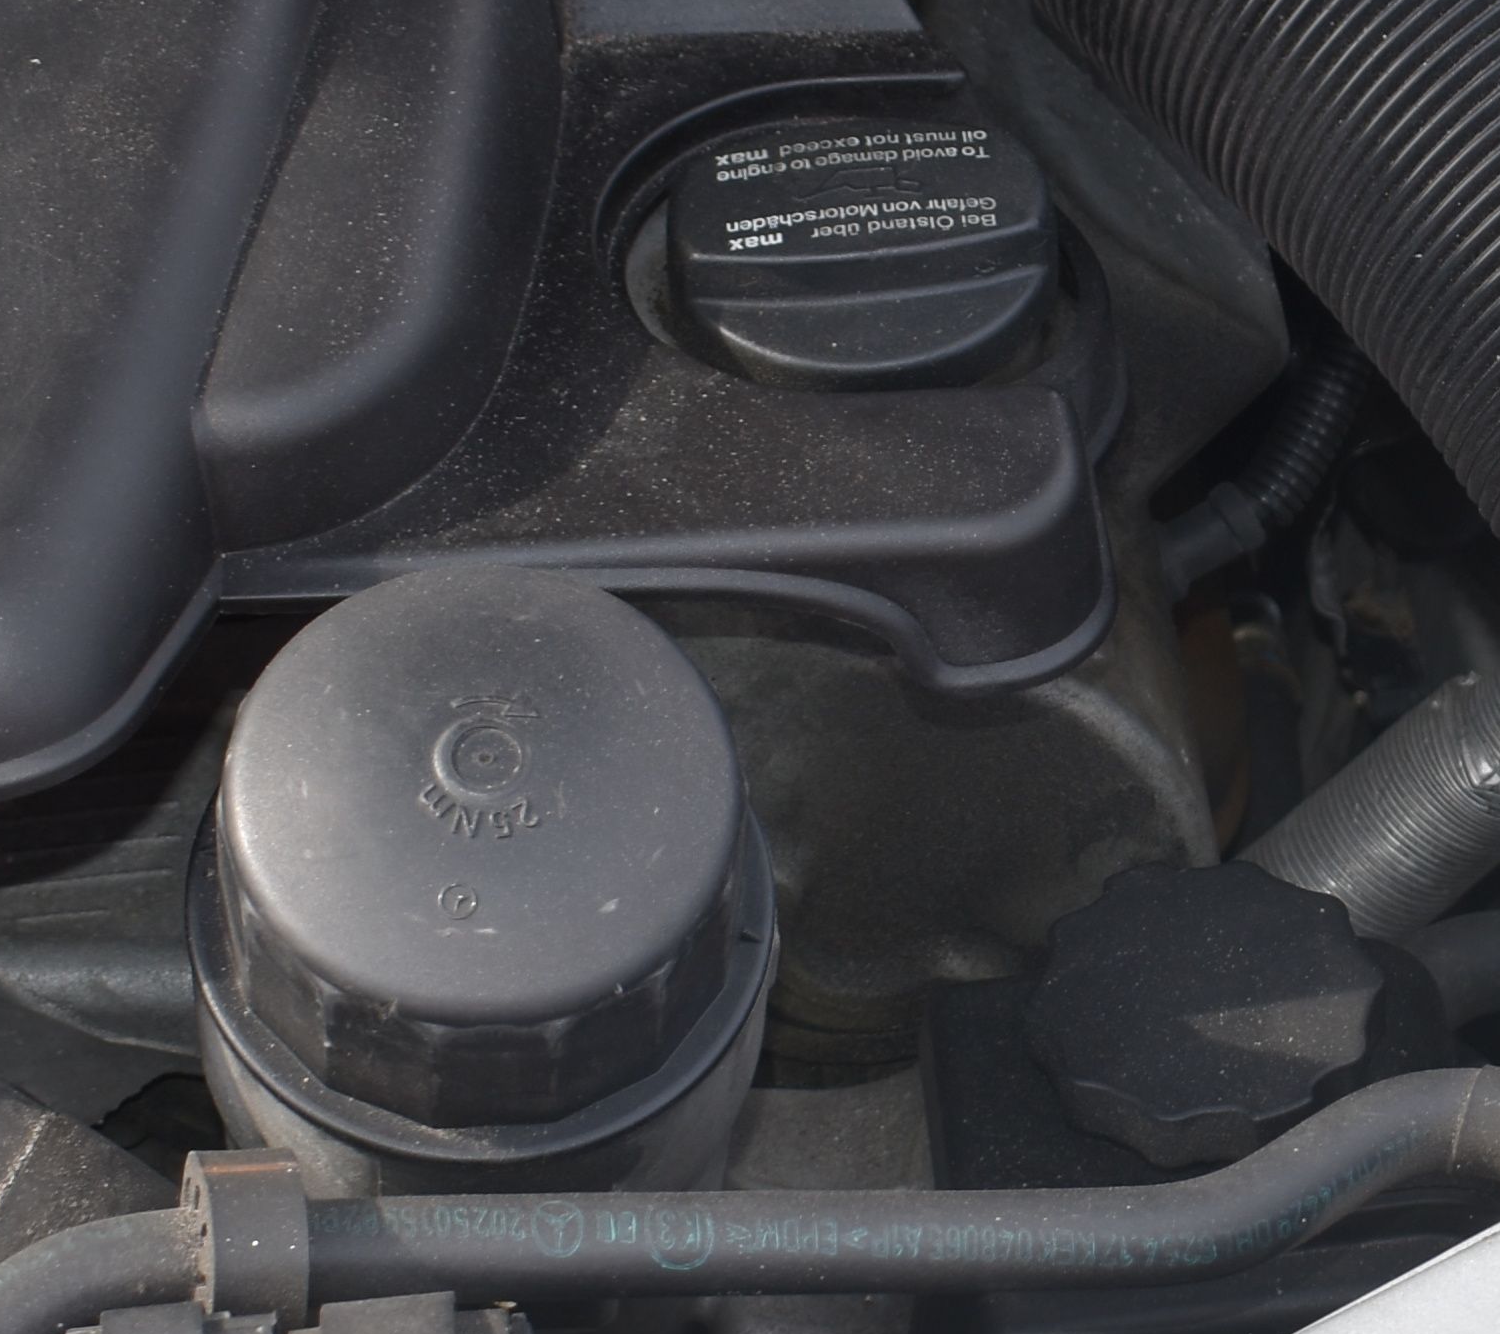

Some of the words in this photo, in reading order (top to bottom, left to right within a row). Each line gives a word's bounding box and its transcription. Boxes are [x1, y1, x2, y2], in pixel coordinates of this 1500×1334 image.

[864, 133, 899, 148] not
[903, 131, 956, 147] must
[961, 129, 987, 145] oil
[779, 136, 860, 157] exceed
[902, 146, 958, 162] avoid
[961, 145, 989, 159] To
[714, 148, 768, 167] max
[791, 158, 810, 170] to
[815, 149, 898, 169] damage
[715, 160, 786, 183] engine
[882, 199, 921, 213] von
[925, 195, 997, 211] Gefahr
[725, 204, 878, 234] Motorschäden
[867, 214, 954, 232] Ölstand
[961, 213, 997, 228] Bei
[810, 221, 860, 239] über
[727, 232, 783, 252] max
